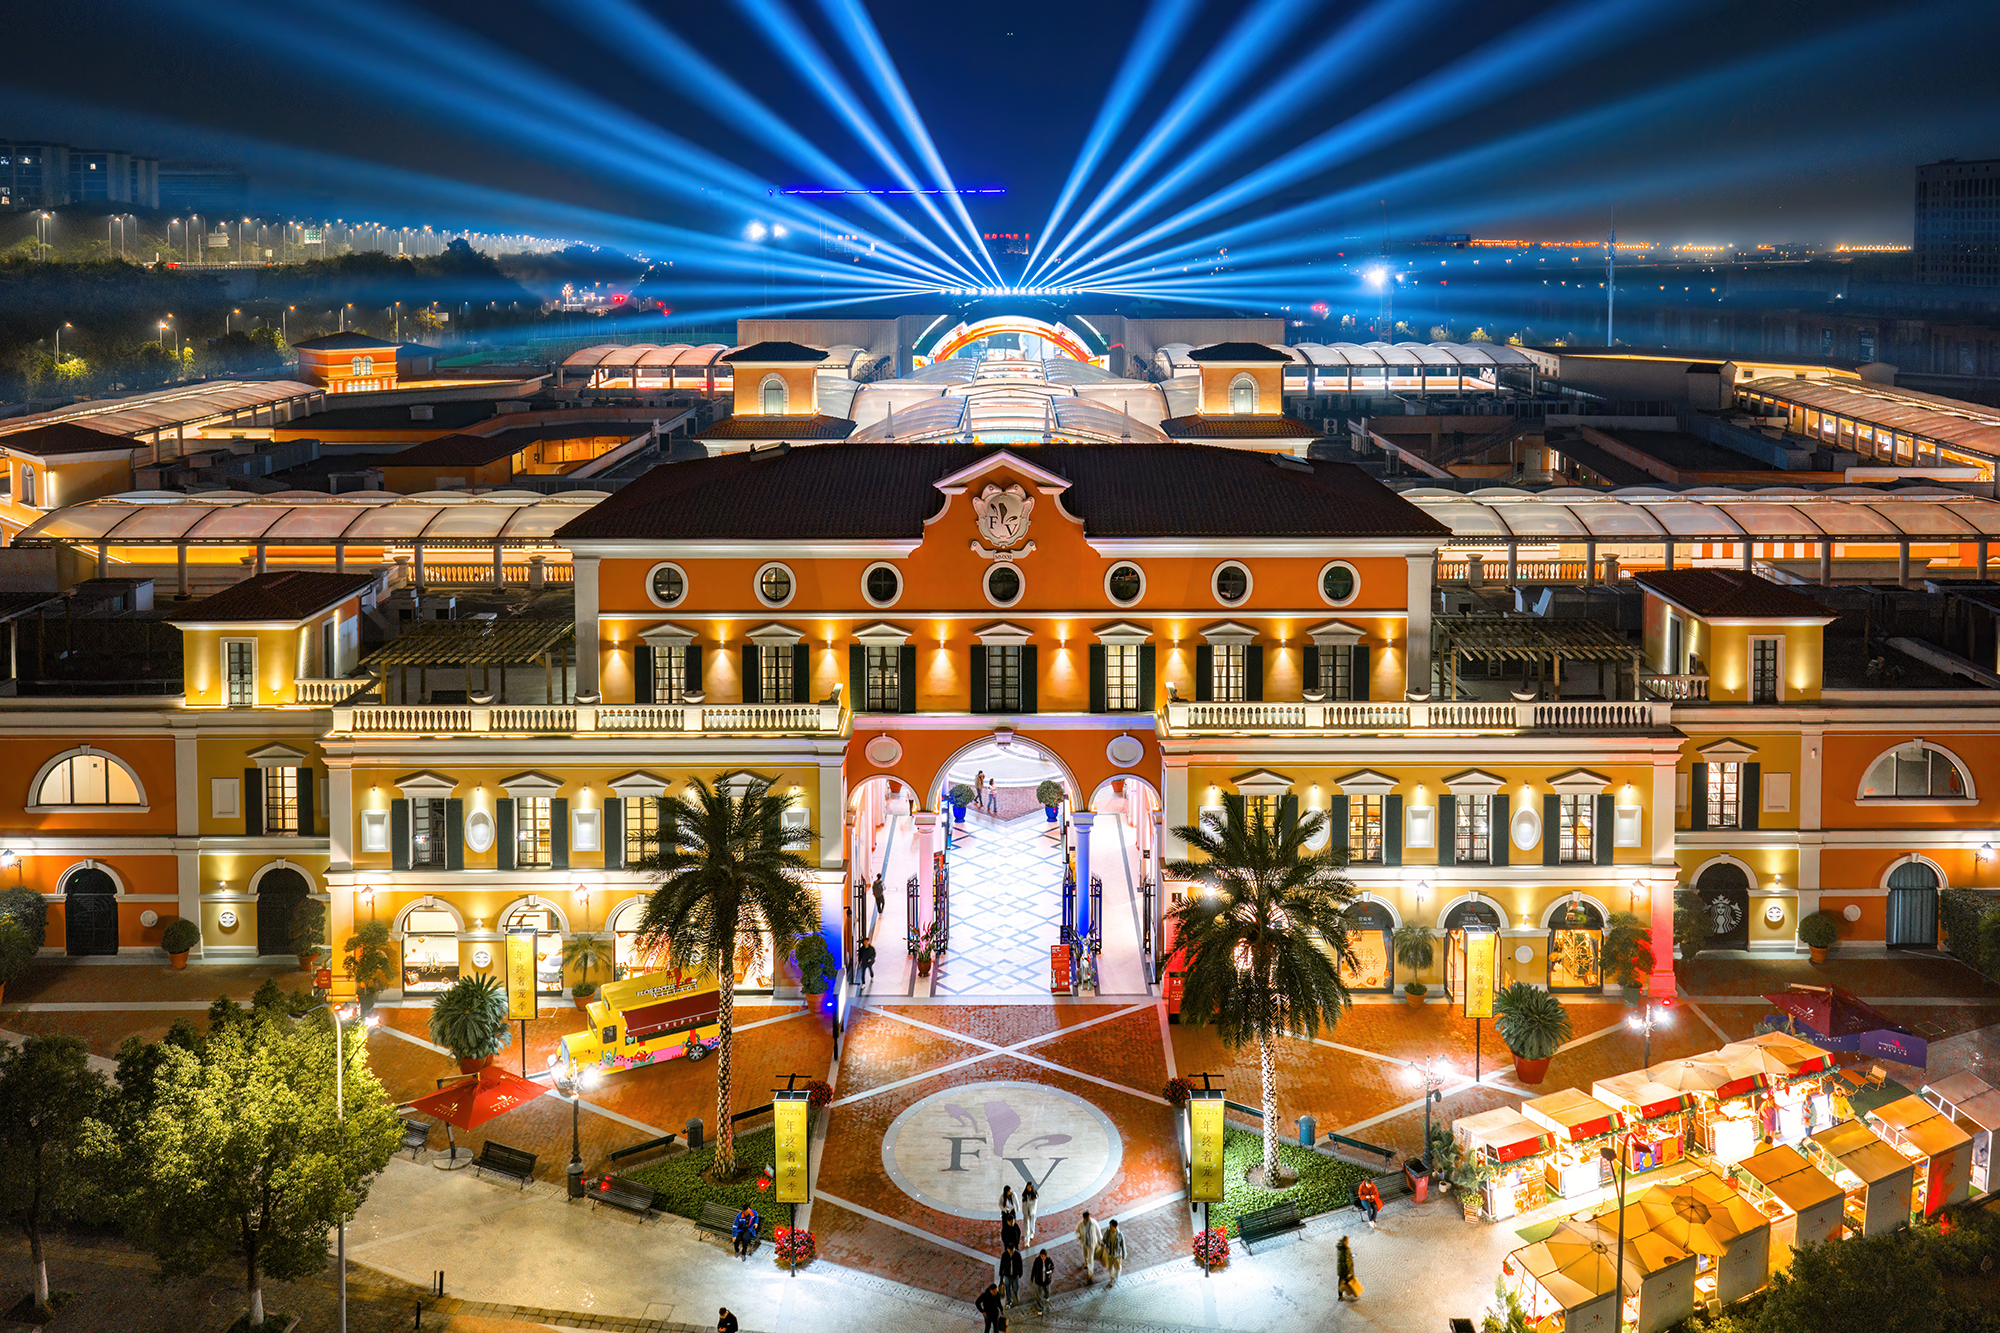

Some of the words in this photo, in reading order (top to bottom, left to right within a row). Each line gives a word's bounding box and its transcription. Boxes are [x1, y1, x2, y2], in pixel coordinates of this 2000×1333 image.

[989, 516, 998, 529] F
[1004, 524, 1018, 536] V
[514, 950, 528, 1011] 年终奢宠季
[652, 984, 698, 998] VILLAGE
[1475, 949, 1486, 1010] 年终奢宠季
[784, 1120, 798, 1193] 年终奢宠季
[941, 1137, 987, 1171] F
[1002, 1157, 1069, 1191] V
[1200, 1119, 1214, 1193] 年终奢宠季
